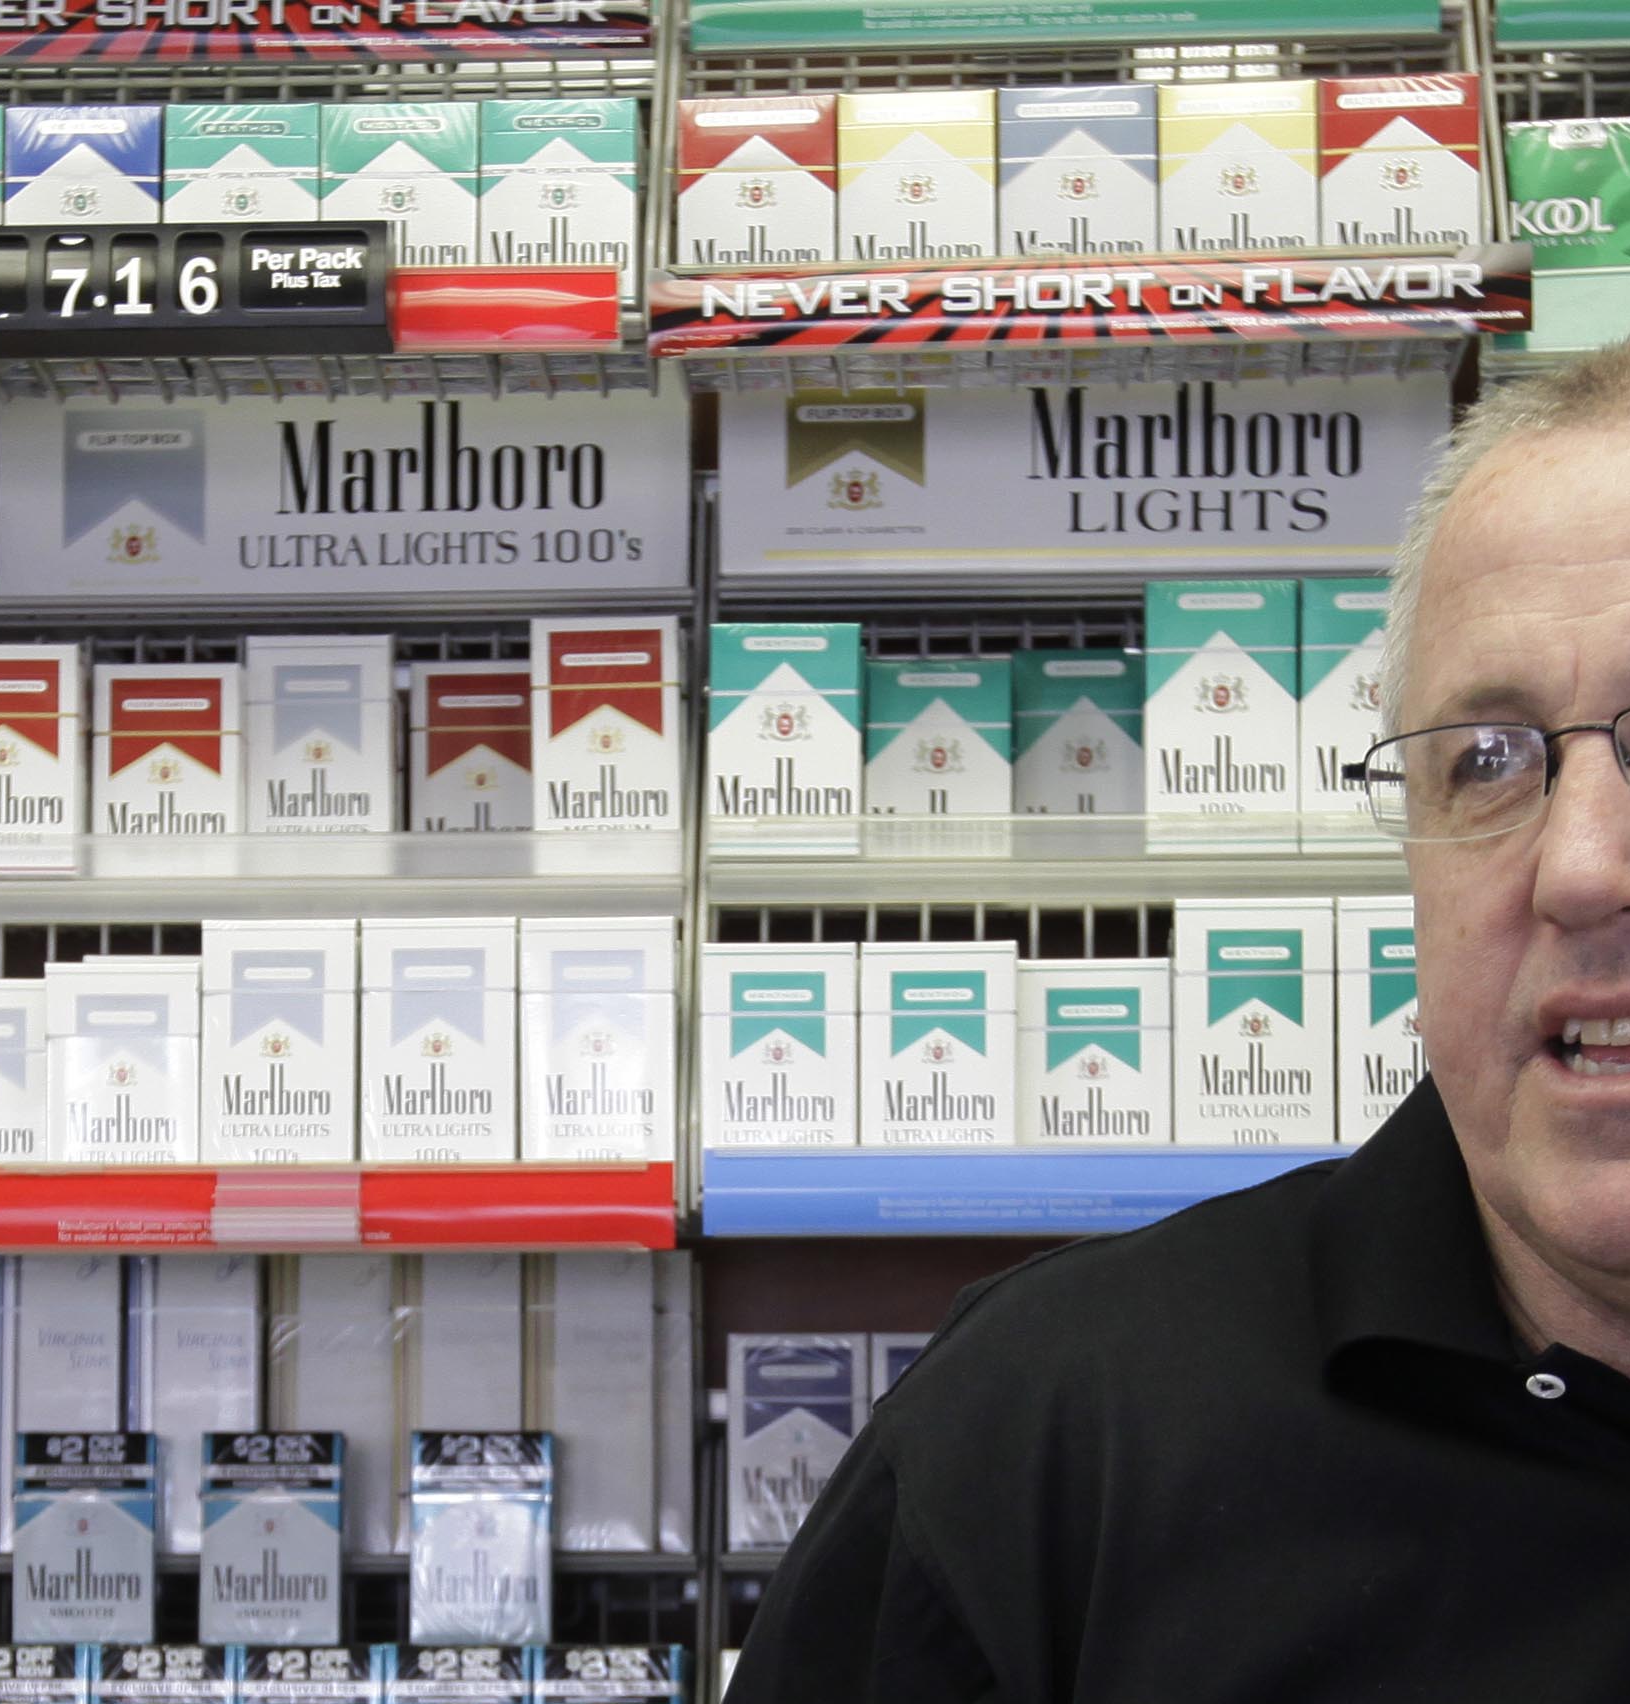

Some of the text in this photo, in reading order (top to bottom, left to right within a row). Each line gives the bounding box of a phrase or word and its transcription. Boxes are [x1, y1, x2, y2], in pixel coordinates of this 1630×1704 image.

[97, 0, 290, 27] SHORT
[311, 4, 361, 25] ON
[388, 0, 608, 25] FLAVOR
[1511, 198, 1613, 236] KOOL
[252, 247, 361, 273] Per Pack
[491, 217, 629, 266] Marlboro
[50, 257, 219, 316] 7.16
[271, 271, 341, 289] Plus Tax
[702, 263, 1485, 318] NEVER SHORT ON FLAVOR
[1027, 382, 1362, 483] Marlboro
[278, 401, 605, 515] Marlboro
[1069, 489, 1330, 533] LIGHTS
[239, 529, 644, 570] ULTRA LIGHTS 100's
[716, 758, 851, 817] Marlboro
[723, 1073, 834, 1123] Marlboro
[1040, 1087, 1150, 1136] Marlboro
[1198, 1103, 1311, 1119] ULTRA LIGHTS
[221, 1122, 330, 1138] ULTRA LIGHTS
[382, 1122, 492, 1138] ULTRA LIGHTS
[212, 1549, 328, 1601] Marlboro
